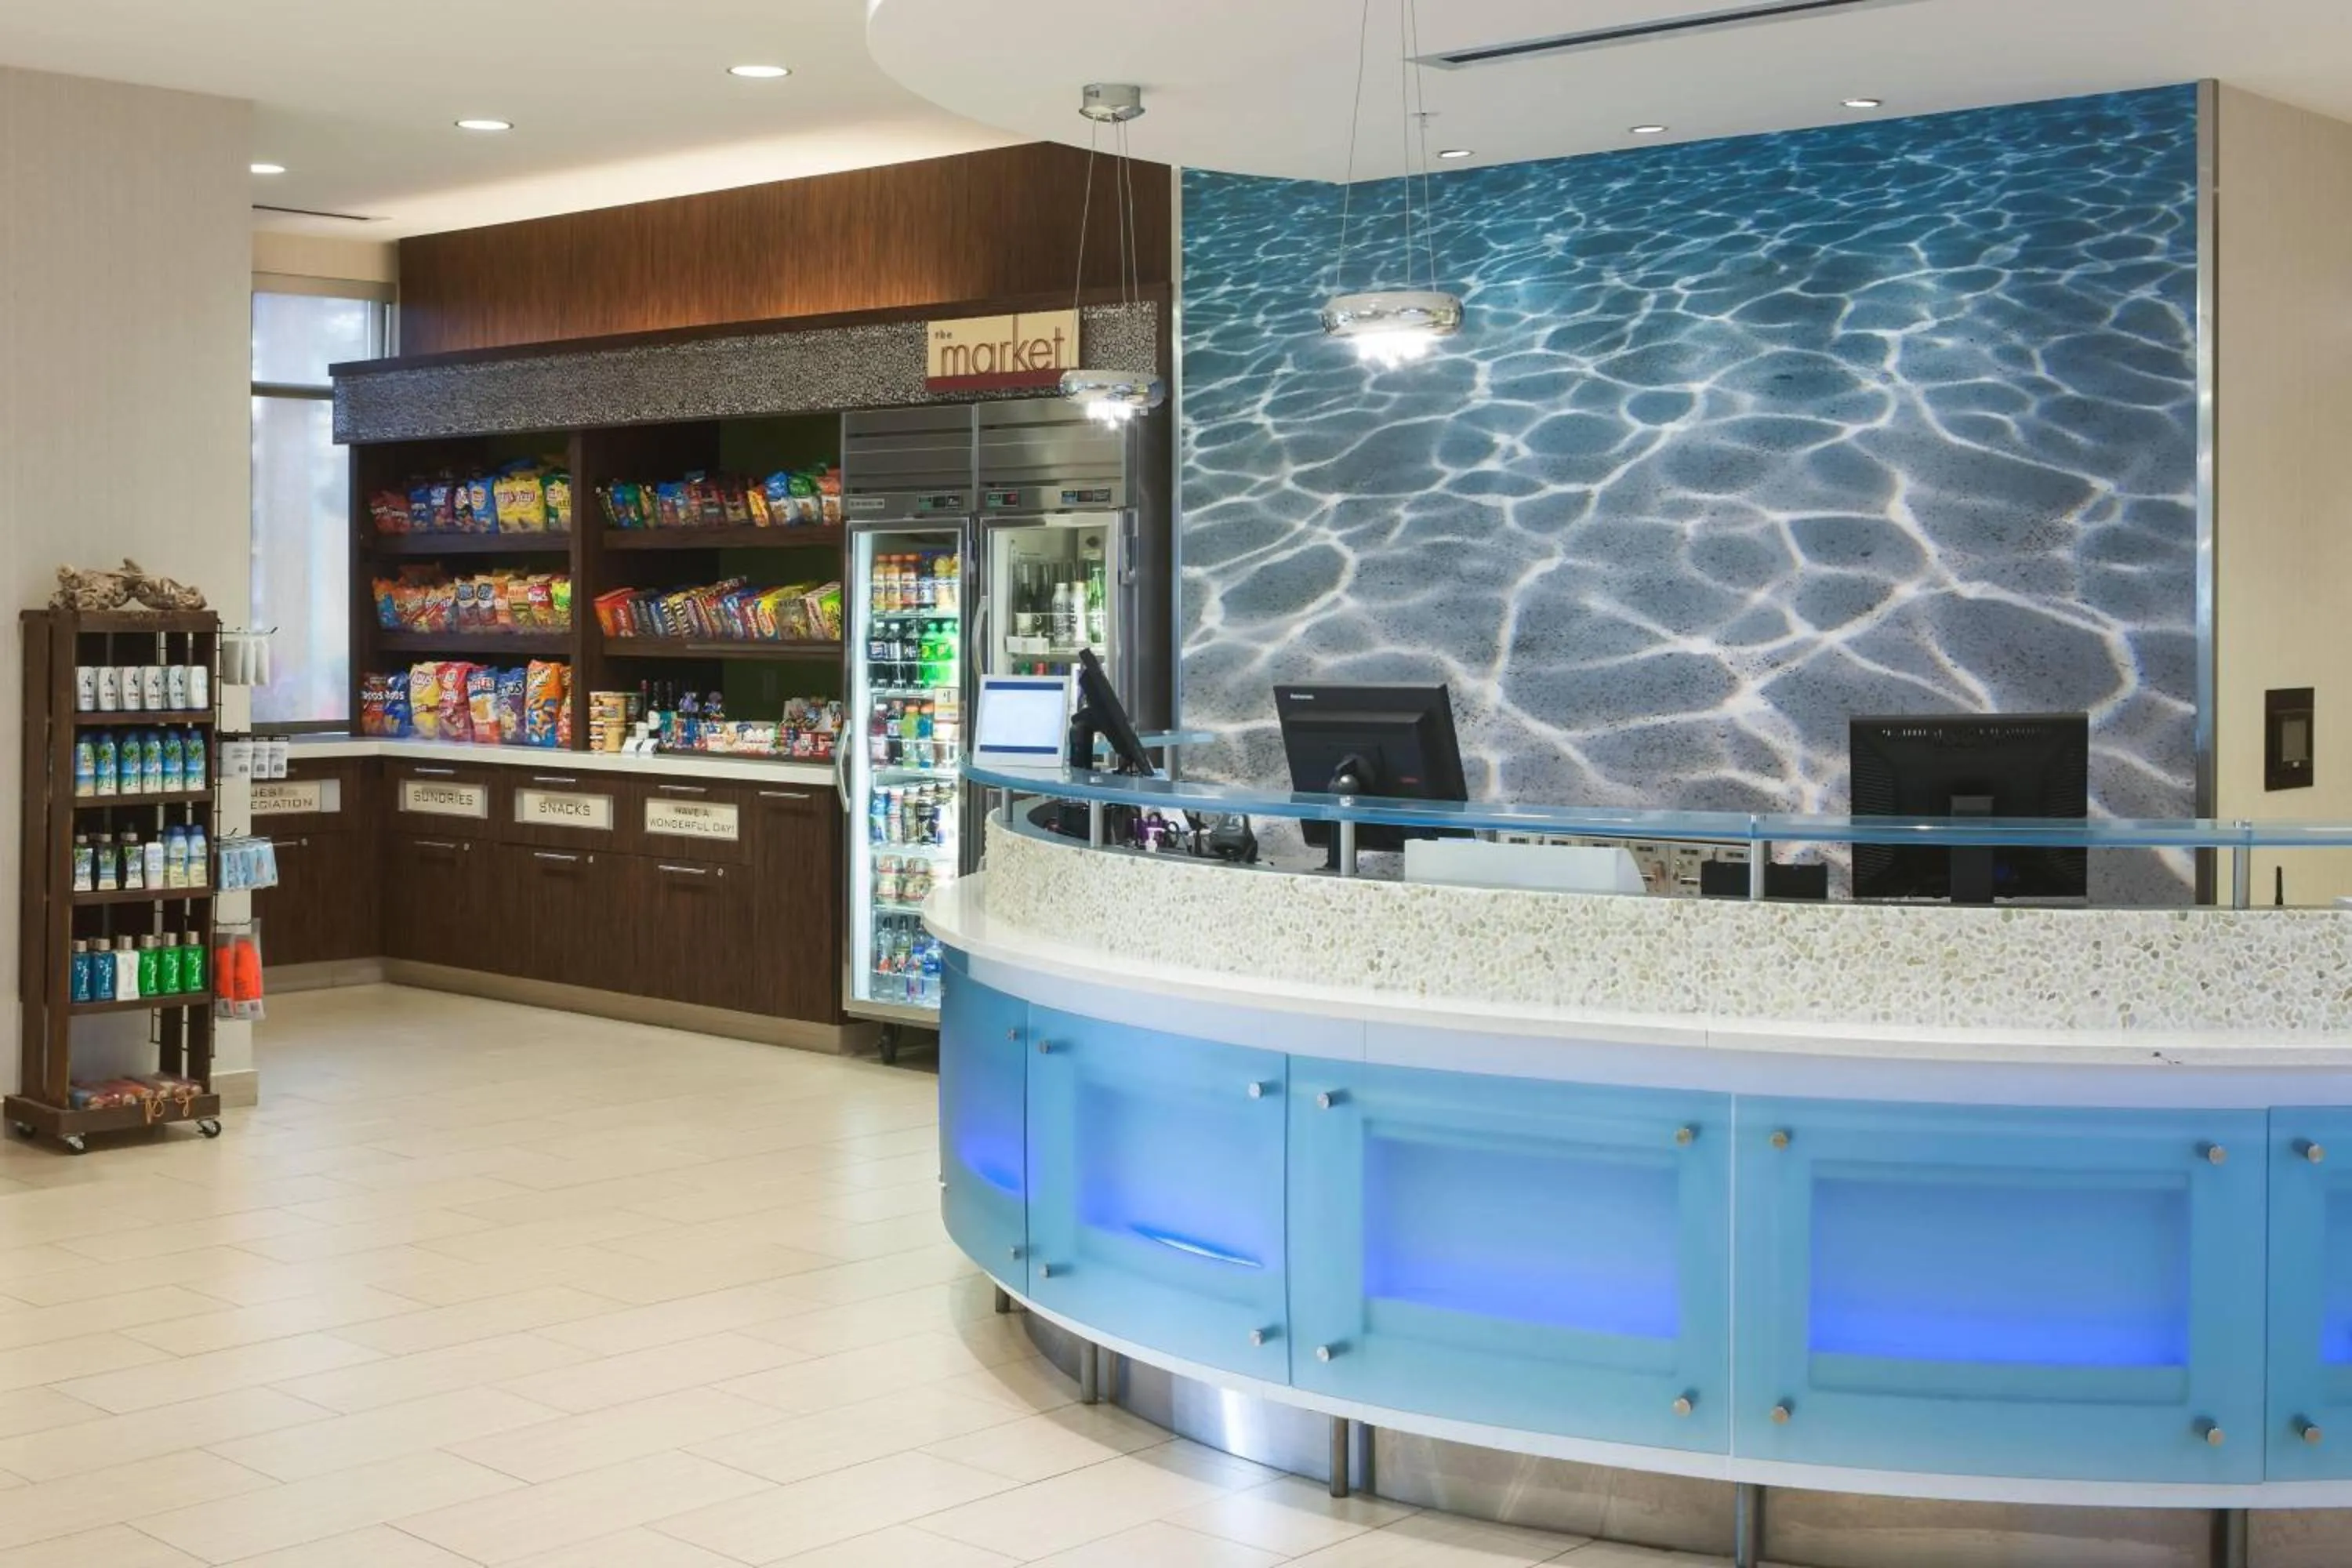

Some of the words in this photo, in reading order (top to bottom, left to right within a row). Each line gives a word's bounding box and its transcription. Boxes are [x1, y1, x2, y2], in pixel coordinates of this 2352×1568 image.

[935, 329, 953, 339] the
[941, 314, 1065, 376] market
[413, 789, 474, 806] SUNDRIES
[539, 801, 590, 816] SNACKS
[675, 807, 699, 817] HAVE
[649, 818, 710, 832] WONDERFUL
